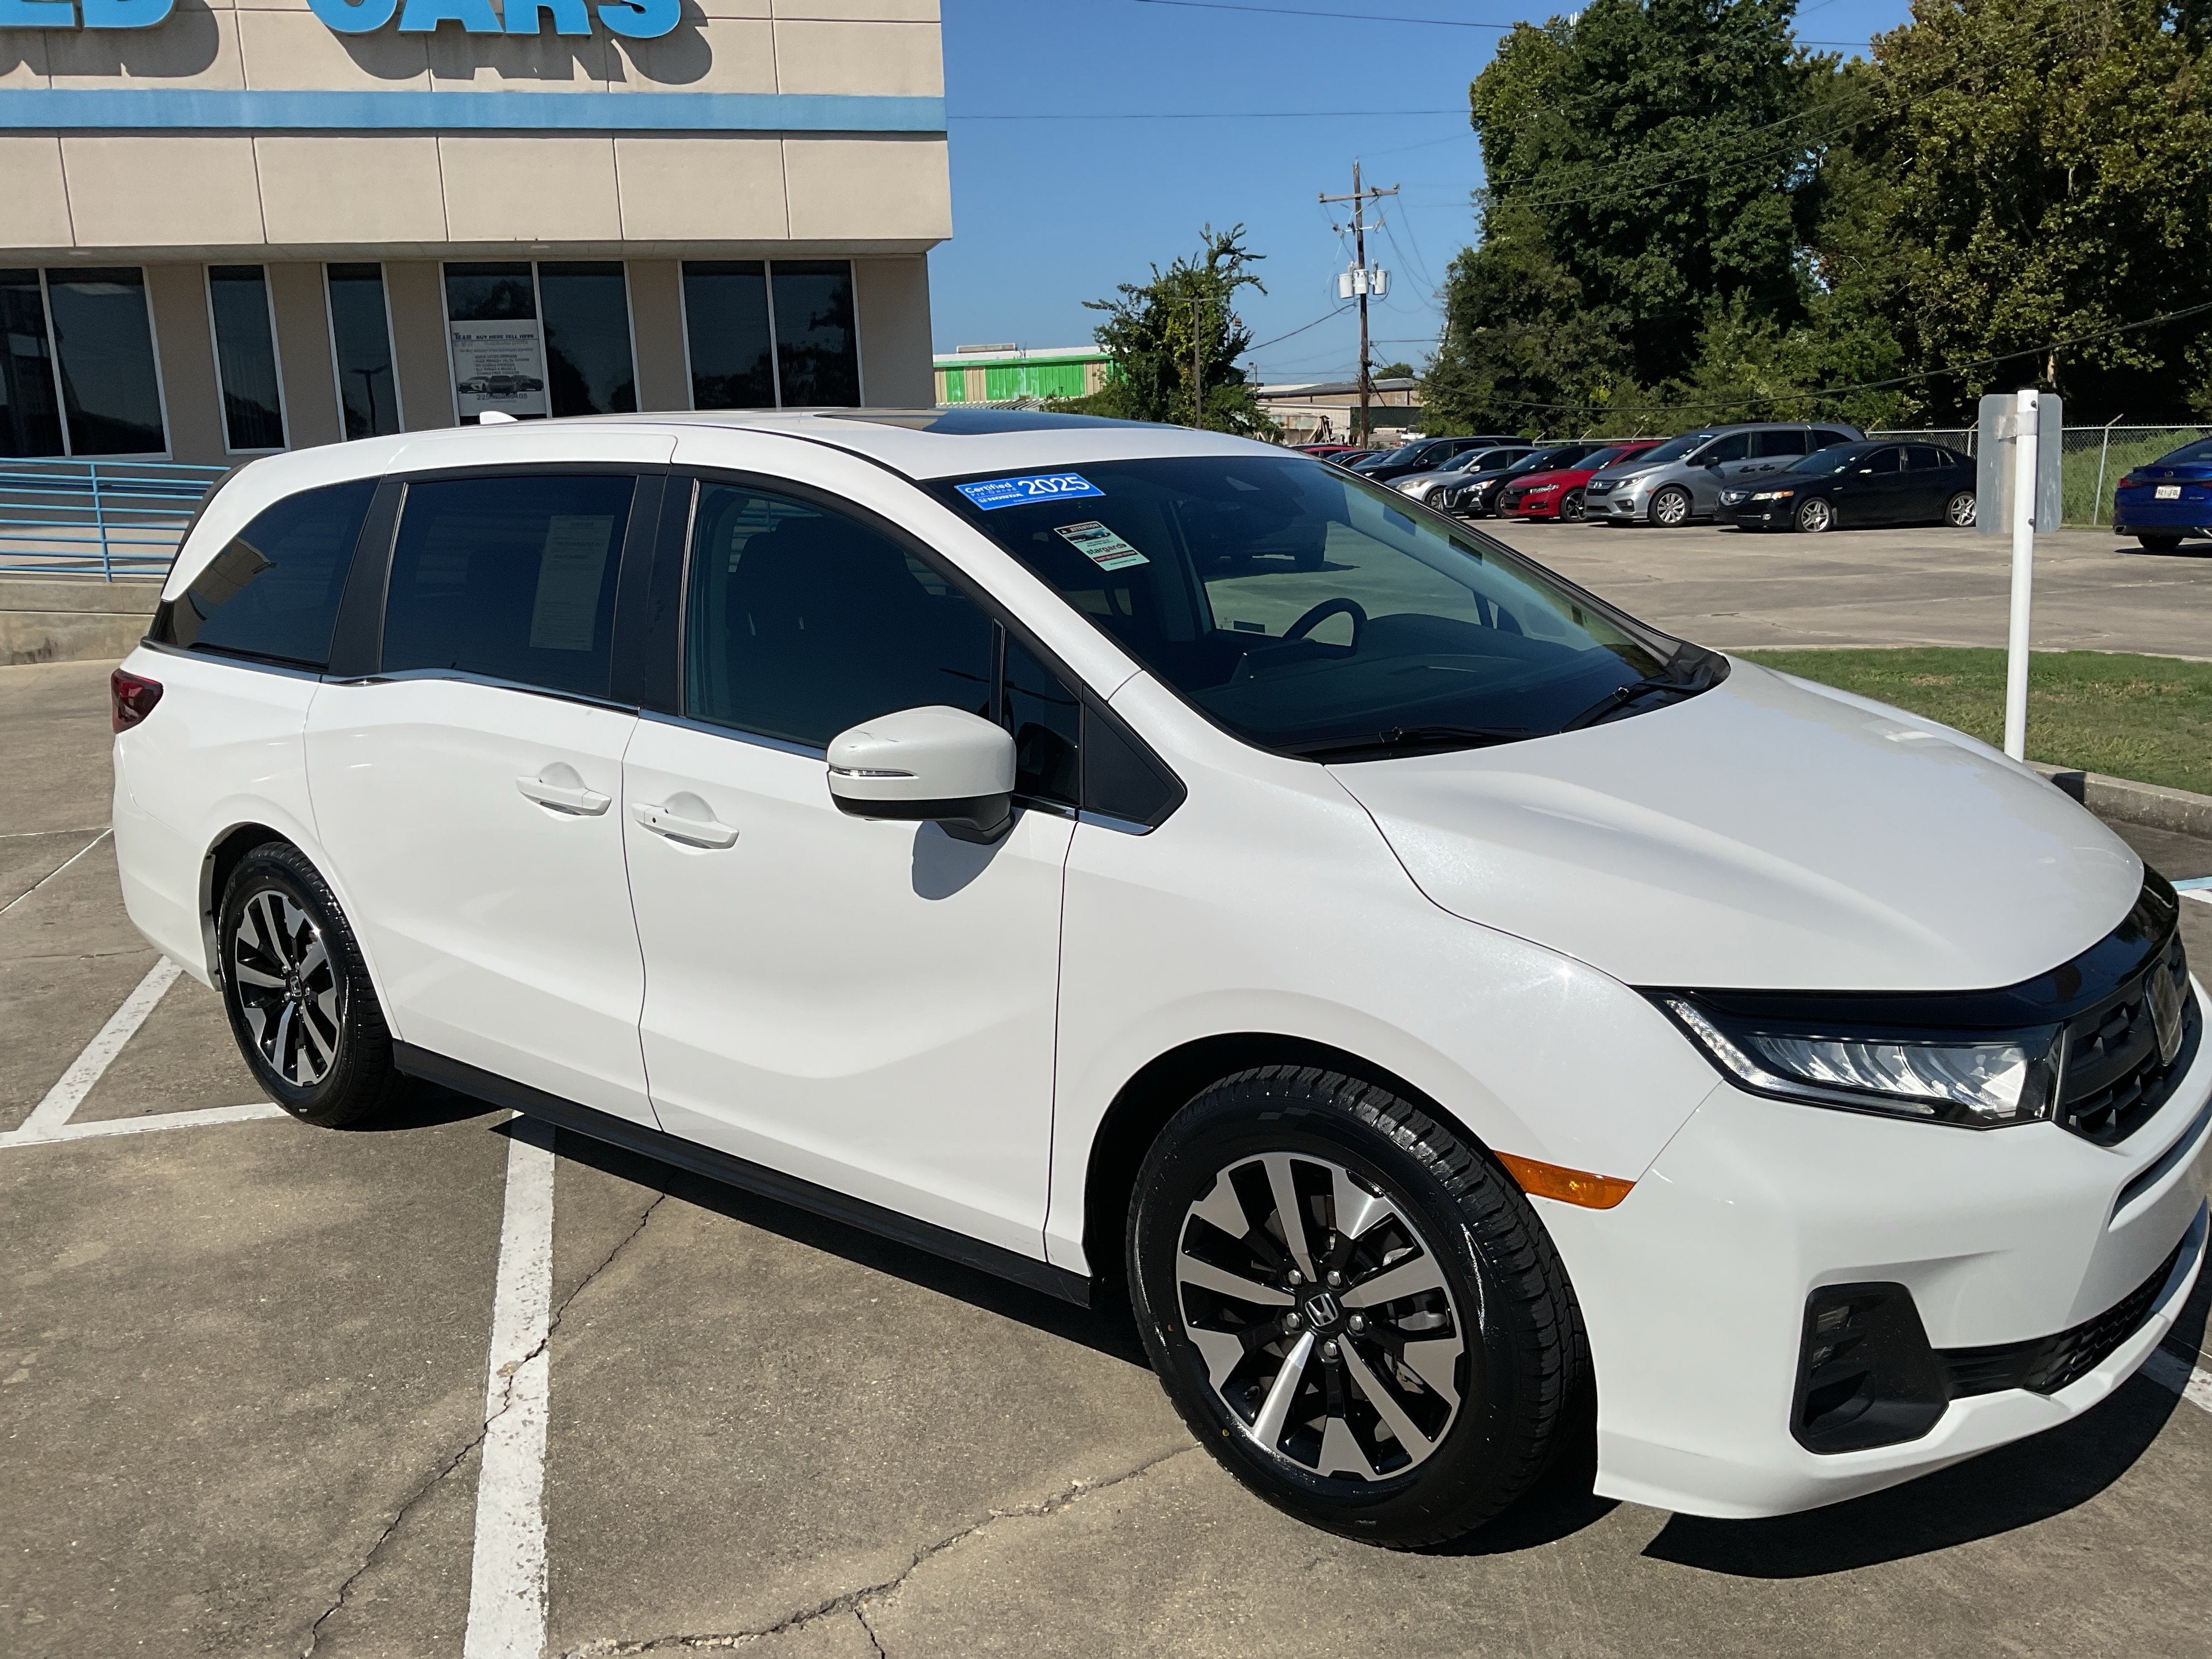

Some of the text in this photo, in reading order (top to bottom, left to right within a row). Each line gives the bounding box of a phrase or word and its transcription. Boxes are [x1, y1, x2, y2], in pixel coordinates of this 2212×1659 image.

[964, 482, 1013, 493] Certified
[1018, 477, 1090, 495] 2025
[987, 493, 1024, 501] HONDA
[1069, 522, 1101, 532] ATTENTION
